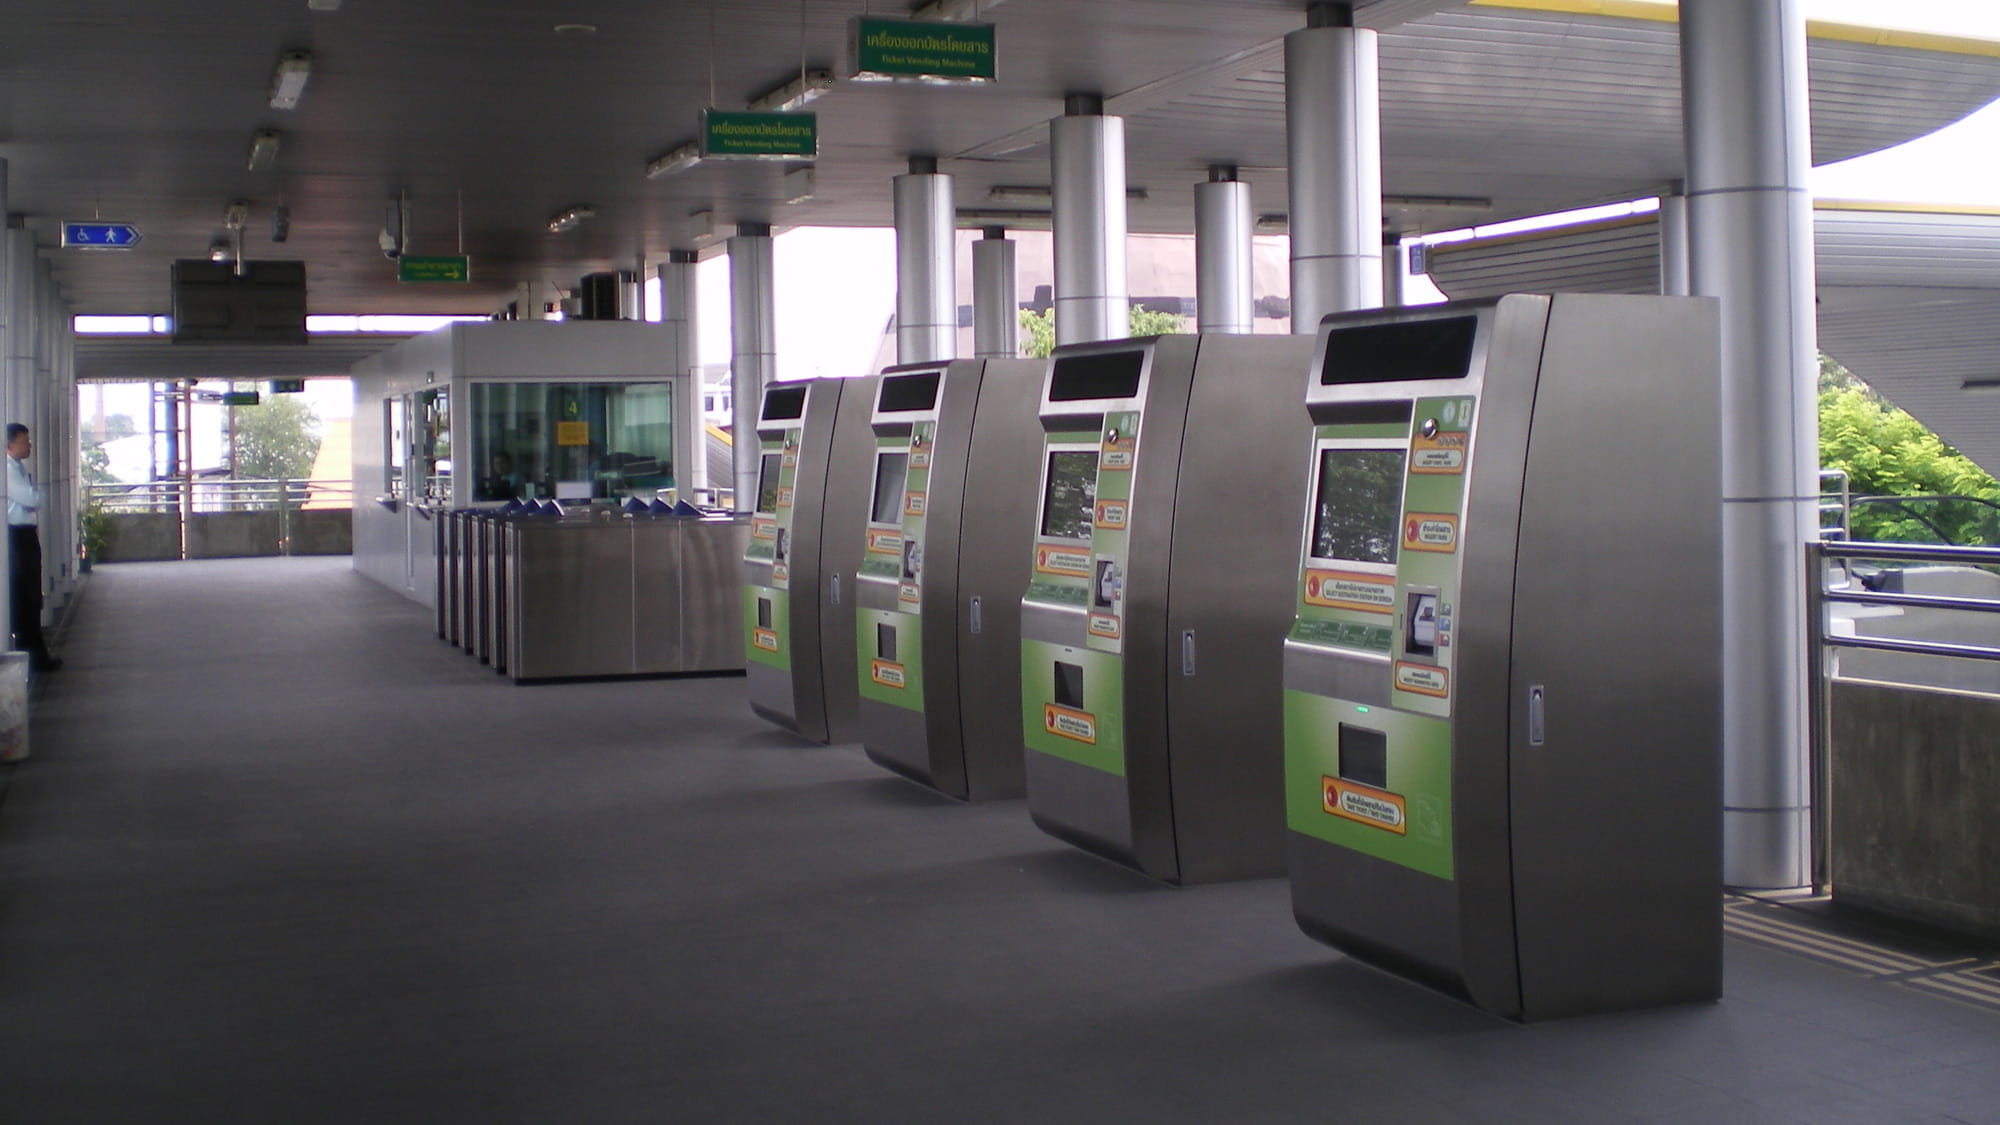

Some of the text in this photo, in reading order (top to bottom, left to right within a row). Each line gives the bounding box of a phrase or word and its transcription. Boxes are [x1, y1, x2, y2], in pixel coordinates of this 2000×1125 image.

[882, 55, 975, 68] Ticket Vending Machine
[724, 139, 743, 147] Ticket
[745, 140, 772, 149] Vending
[568, 401, 577, 414] 4
